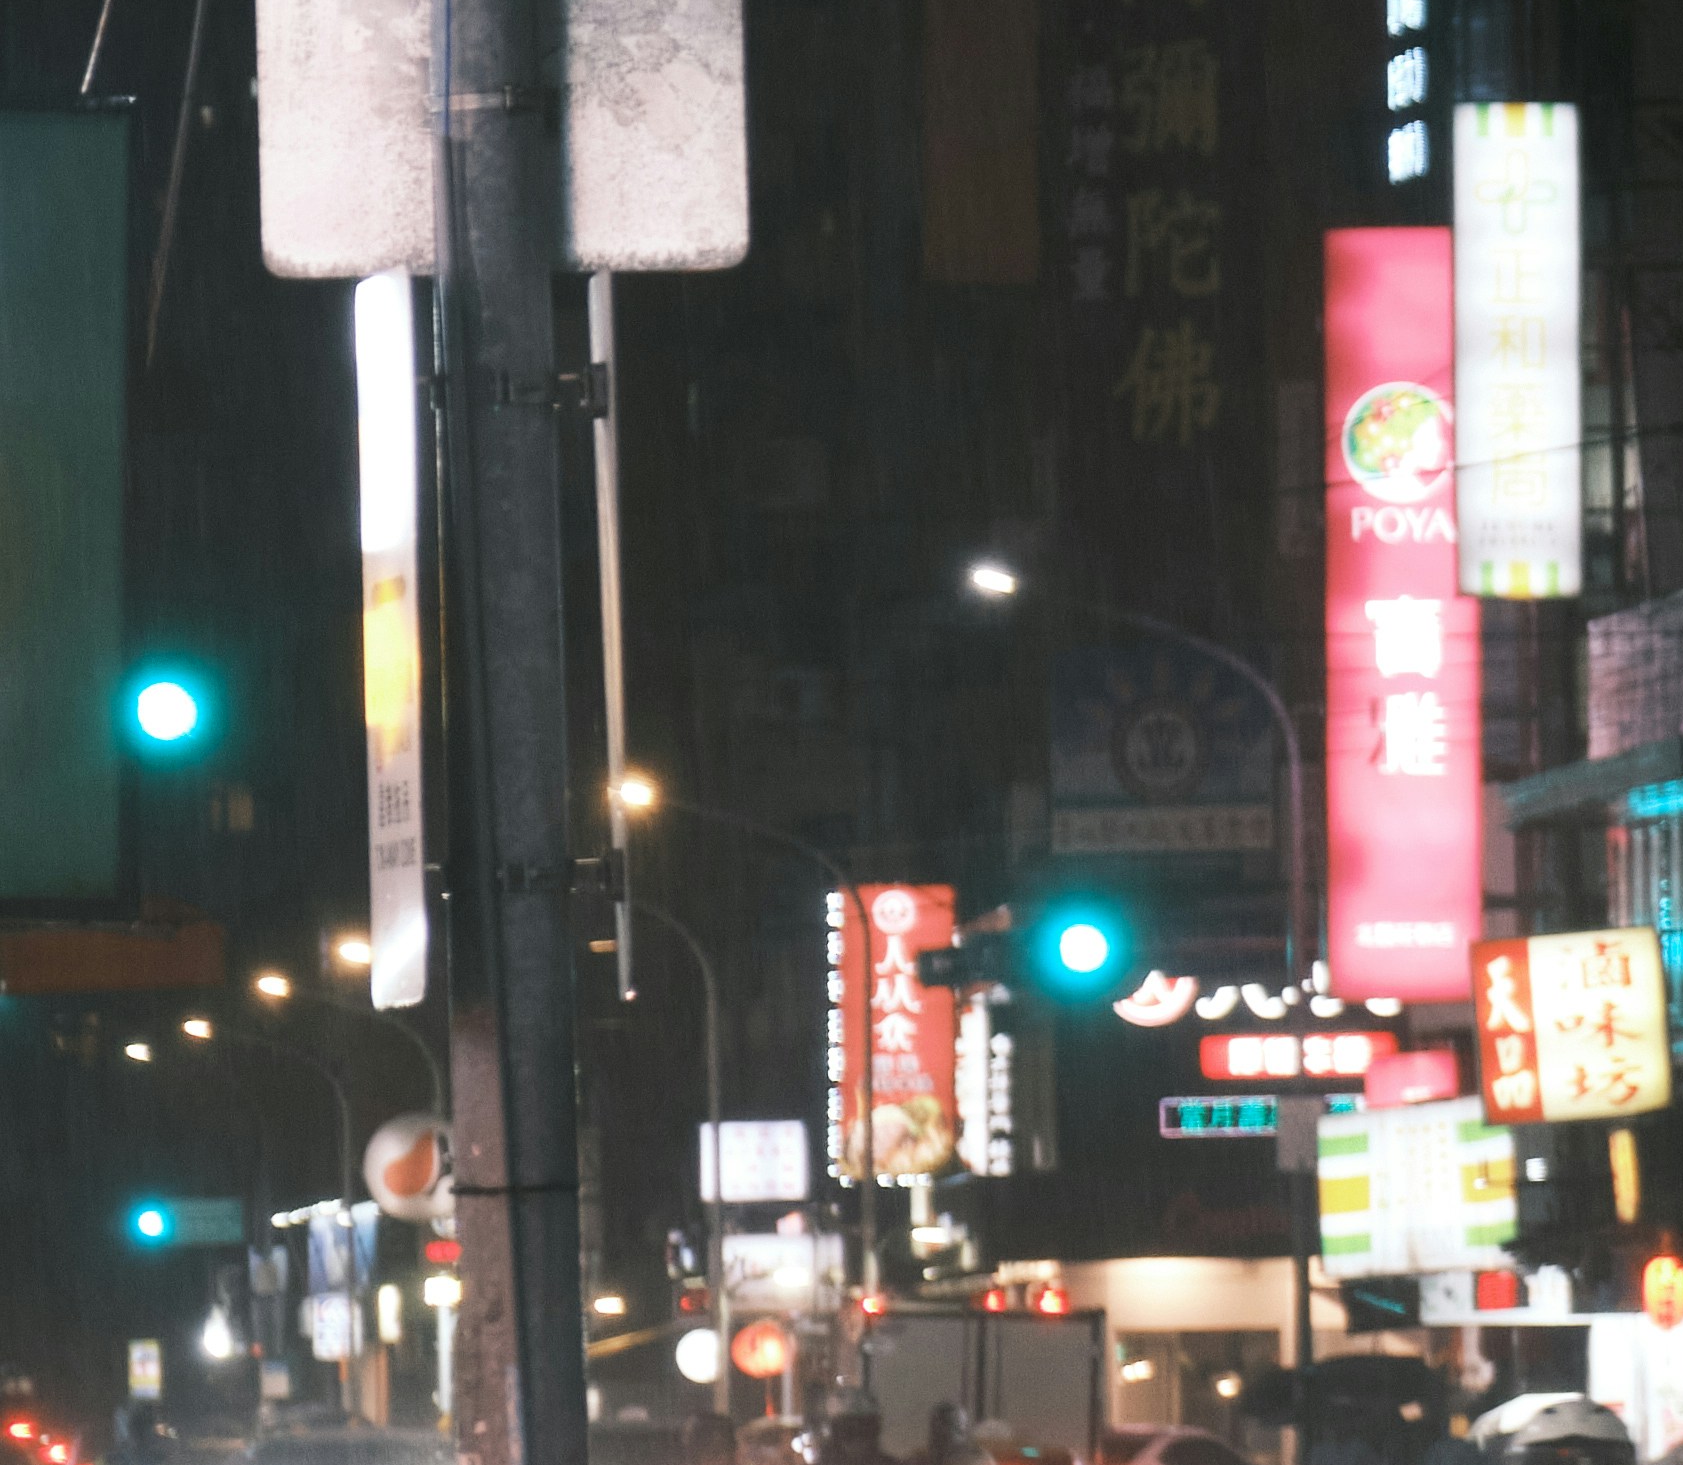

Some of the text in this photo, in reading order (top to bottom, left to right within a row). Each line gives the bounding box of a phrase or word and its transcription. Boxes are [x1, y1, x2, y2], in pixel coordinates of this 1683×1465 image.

[1351, 506, 1455, 544] POYA
[1553, 940, 1645, 1106] 滷味坊
